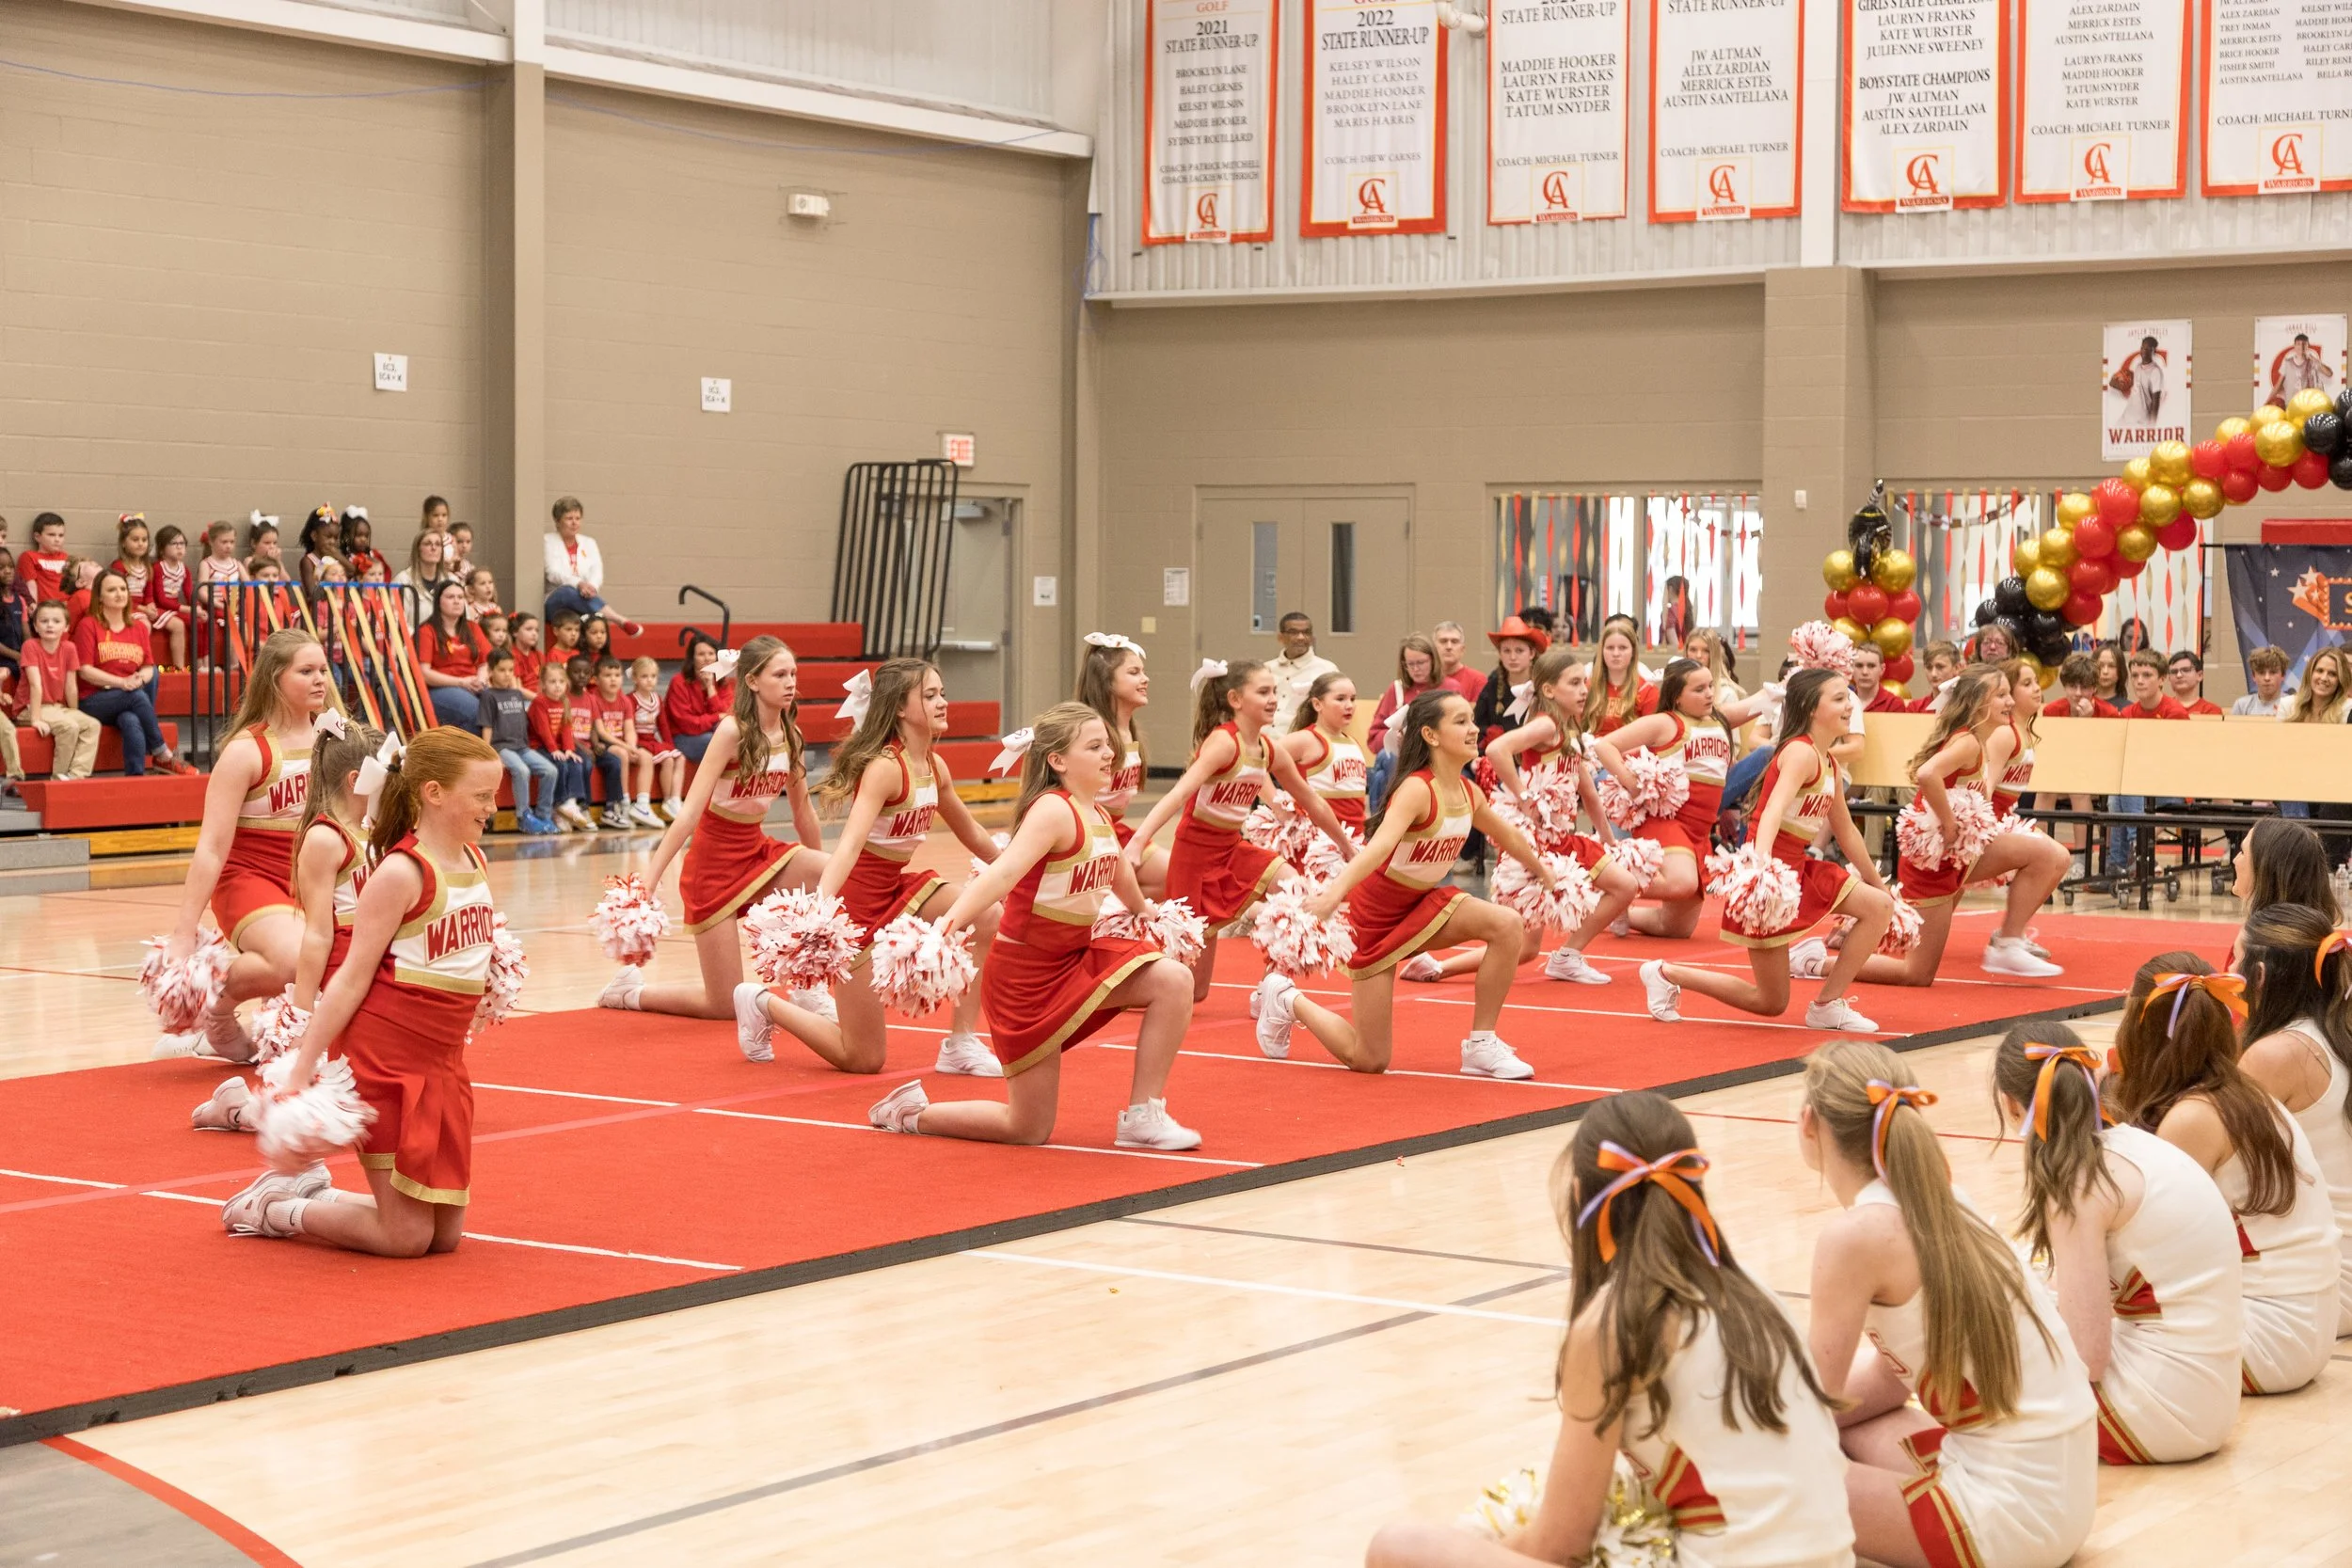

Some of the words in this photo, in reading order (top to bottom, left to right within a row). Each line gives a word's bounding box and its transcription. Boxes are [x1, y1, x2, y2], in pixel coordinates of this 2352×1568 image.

[1196, 1, 1230, 12] GOLF
[1502, 8, 1541, 24] STATE
[1543, 2, 1617, 22] RUNNER-UP
[1668, 0, 1708, 14] STATE
[2070, 3, 2094, 16] ALEX
[2096, 2, 2141, 14] ZARDAIN
[2301, 4, 2332, 14] KELSEY
[1357, 9, 1394, 27] 2022
[1878, 12, 1925, 26] LAURYN
[1928, 8, 1976, 24] FRANKS
[2220, 9, 2241, 20] ALEX
[2296, 17, 2329, 27] MADDIE
[2331, 15, 2352, 25] HOO
[1197, 20, 1228, 36] 2021
[2068, 18, 2110, 30] MERRICK
[2112, 16, 2142, 27] ESTES
[2220, 24, 2240, 33] TREY
[2242, 21, 2272, 31] INMAN
[1322, 31, 1358, 51] STATE
[1359, 26, 1429, 48] RUNNER-UP
[1880, 28, 1910, 41] KATE
[1912, 24, 1973, 39] WURSTER
[2054, 33, 2090, 46] AUSTIN
[2091, 30, 2154, 43] SANTELLANA
[2219, 36, 2257, 46] MERRICK
[2259, 34, 2282, 43] ESTES
[2296, 30, 2343, 40] BROOKLYN
[1166, 38, 1197, 54] STATE
[1199, 33, 1259, 51] RUNNER-UP
[1866, 42, 1926, 60] JULIENNE
[1928, 38, 1985, 54] SWEENEY
[2303, 43, 2331, 53] HALEY
[2333, 41, 2352, 51] CAR
[1692, 50, 1708, 63] JW
[1709, 46, 1762, 62] ALTMAN
[2064, 55, 2103, 67] LAURYN
[2104, 52, 2144, 64] FRANKS
[2219, 50, 2244, 59] BRICE
[2245, 47, 2280, 57] HOOKER
[1329, 59, 1372, 71] KELSEY
[1375, 56, 1421, 69] WILSON
[1501, 57, 1554, 74] MADDIE
[1558, 53, 1617, 70] HOOKER
[1682, 64, 1713, 78] ALEX
[1715, 60, 1772, 75] ZARDIAN
[2219, 62, 2248, 72] FISHER
[2249, 60, 2276, 71] SMITH
[2306, 57, 2330, 67] RILEY
[1331, 73, 1370, 86] HALEY
[1374, 71, 1418, 83] CARNES
[1502, 72, 1557, 88] LAURYN
[1561, 68, 1614, 85] FRANKS
[1859, 76, 1885, 90] BOYS
[1886, 73, 1920, 87] STATE
[1922, 68, 1991, 87] CHAMPIONS
[2102, 67, 2145, 79] HOOKER
[2219, 75, 2249, 86] AUSTIN
[2250, 71, 2304, 84] SANTELLANA
[2317, 70, 2343, 79] BELLA
[1680, 77, 1735, 92] MERRICK
[1738, 75, 1772, 89] ESTES
[2065, 84, 2101, 95] TATUM
[2101, 81, 2140, 93] SNYDER
[1325, 88, 1371, 100] MADDIE
[1374, 86, 1426, 98] HOOKER
[1505, 88, 1542, 103] KATE
[1546, 85, 1610, 100] WURSTER
[1663, 94, 1708, 108] AUSTIN
[1709, 89, 1788, 105] SANTELLANA
[1887, 92, 1906, 106] JW
[1908, 89, 1960, 104] ALTMAN
[1326, 102, 1390, 114] BROOKLYN
[1392, 99, 1422, 111] LANE
[1505, 103, 1554, 119] TATUM
[1557, 99, 1611, 115] SNYDER
[2066, 98, 2091, 109] KATE
[2093, 95, 2138, 107] WURSTER
[1862, 107, 1905, 121] AUSTIN
[1907, 103, 1987, 119] SANTELLANA
[2217, 115, 2261, 126] COACH:
[2263, 111, 2314, 123] MICHAEL
[2318, 108, 2352, 120] TURN
[1334, 117, 1370, 129] MARIS
[1372, 114, 1415, 126] HARRIS
[1880, 122, 1909, 135] ALEX
[1913, 119, 1969, 134] ZARDAIN
[2075, 120, 2123, 134] MICHAEL
[2126, 119, 2171, 132] TURNER
[1700, 143, 1745, 155] MICHAEL
[1749, 141, 1789, 153] TURNER
[1534, 153, 1577, 166] MICHAEL
[1581, 151, 1618, 163] TURNER
[2108, 426, 2185, 445] WARRIOR
